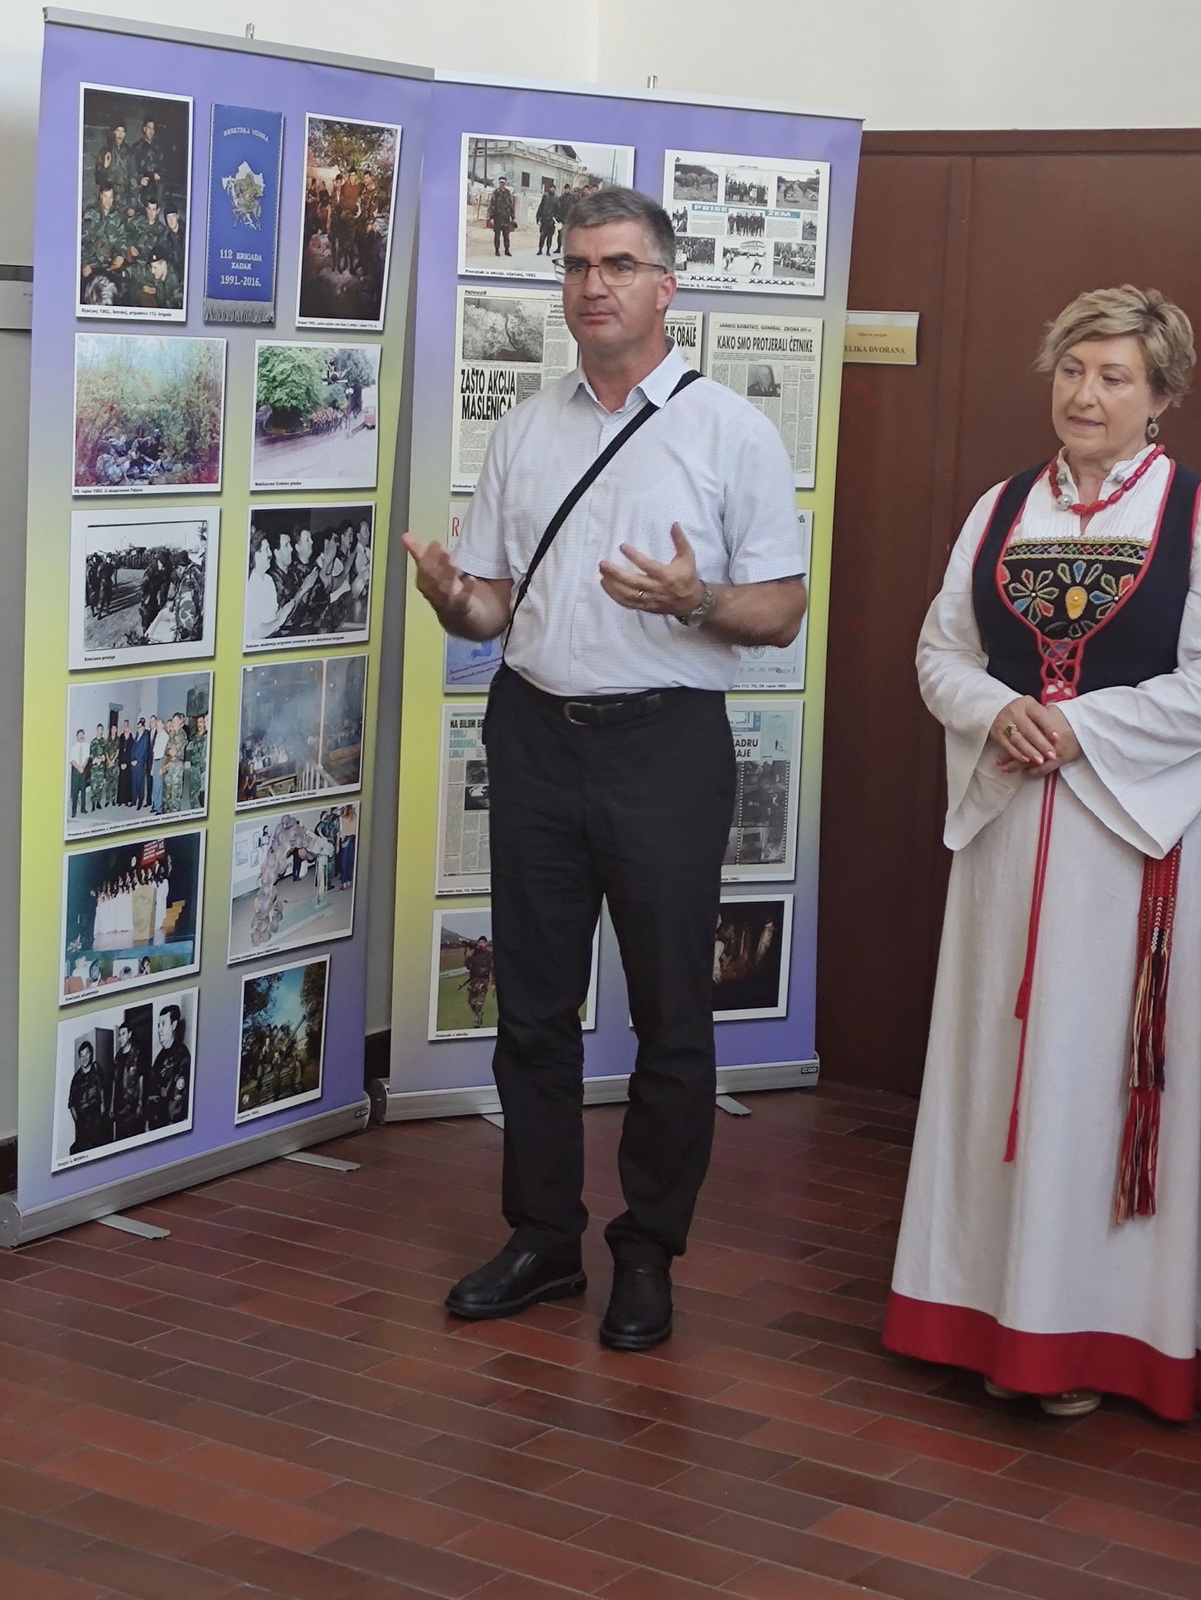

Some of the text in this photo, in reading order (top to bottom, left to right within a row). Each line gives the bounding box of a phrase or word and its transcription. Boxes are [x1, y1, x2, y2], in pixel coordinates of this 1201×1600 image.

[220, 249, 263, 261] 112 BRIGADA
[231, 262, 252, 270] ZADAR
[220, 275, 262, 287] 1991.-2016.
[676, 325, 697, 347] OBALE
[717, 335, 813, 352] KAKO SMO PROTJERALI ČETNIKE
[844, 345, 906, 354] ELIKA DVORANA
[460, 368, 485, 395] ZAŠTO
[487, 370, 516, 396] AKCIJA
[450, 719, 458, 728] NA
[733, 738, 758, 747] ADRU
[735, 749, 751, 758] AJE
